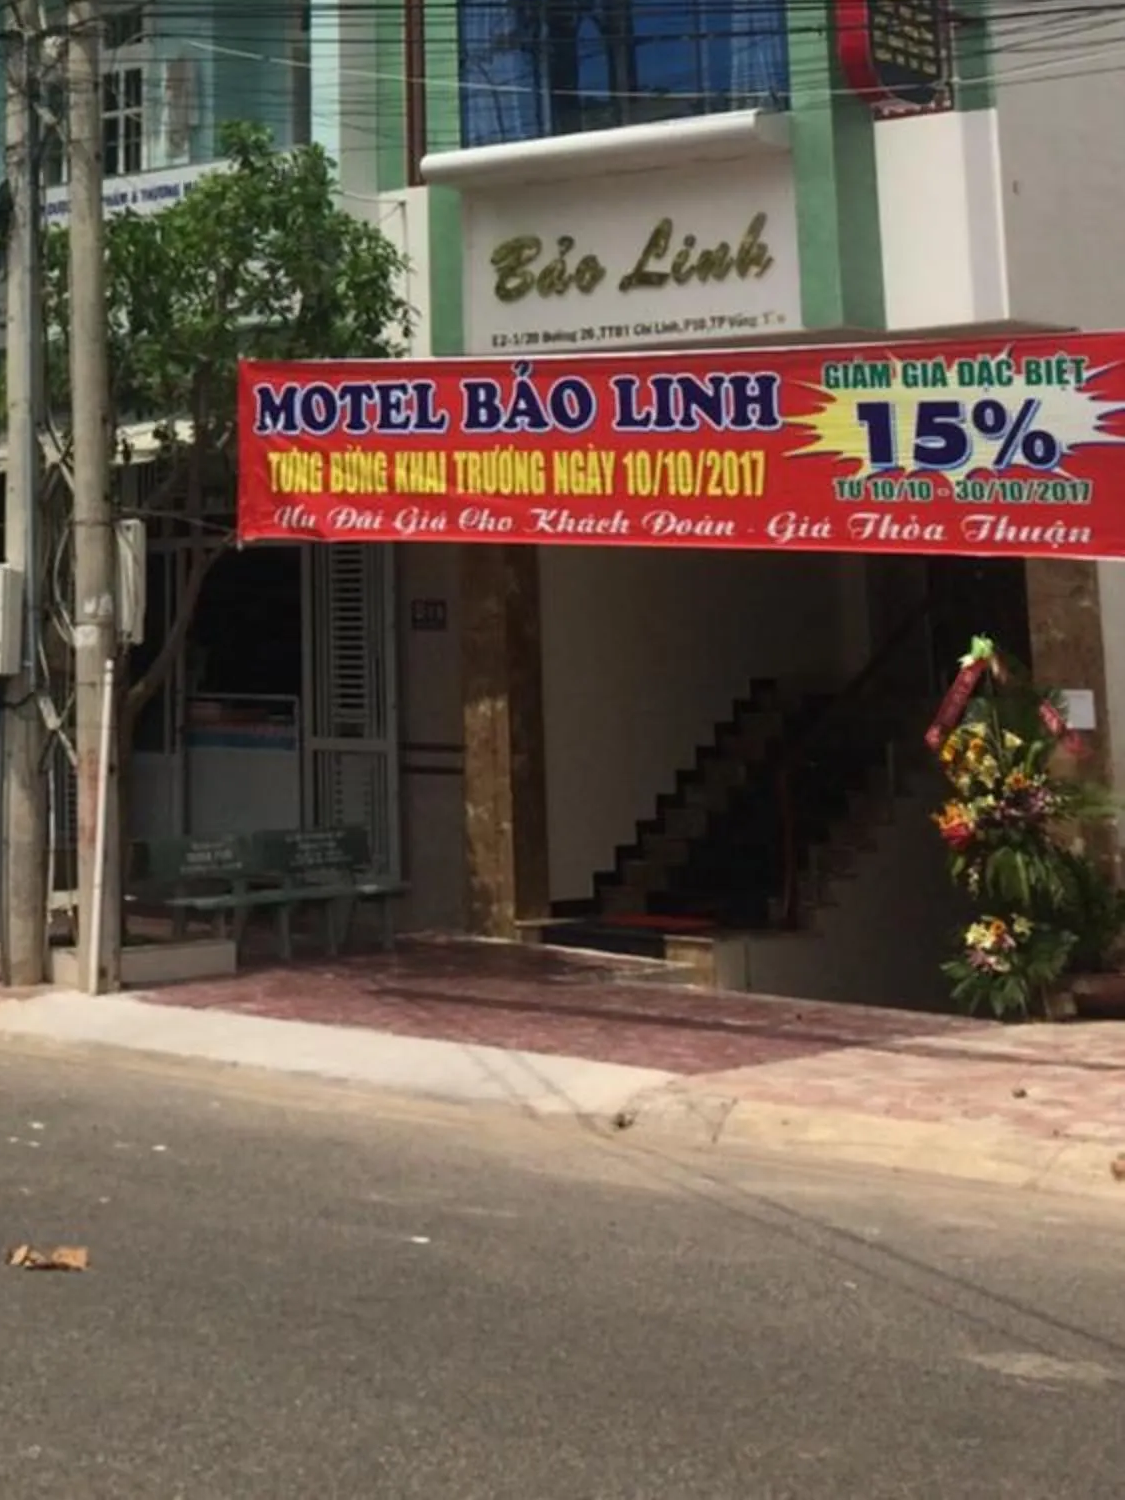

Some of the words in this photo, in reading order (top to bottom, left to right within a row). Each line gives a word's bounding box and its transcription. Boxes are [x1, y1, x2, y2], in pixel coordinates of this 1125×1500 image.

[490, 234, 607, 303] Bảo
[619, 211, 774, 294] Linh
[253, 381, 449, 437] MOTEL
[461, 359, 596, 435] BẢO
[610, 371, 784, 433] LINH
[901, 357, 949, 389] GIÁ
[1024, 352, 1089, 391] BIỆT
[856, 397, 1062, 470] 15%
[394, 450, 448, 495] KHAI
[554, 443, 616, 496] NGÀY
[623, 449, 765, 496] 10/10/2017
[868, 479, 932, 502] 10/10
[954, 479, 1093, 504] 30/10/2017
[392, 505, 448, 534] Giá
[458, 505, 513, 532] Cho
[527, 507, 630, 534] Khách
[765, 510, 832, 544] Giá
[960, 514, 1093, 549] Thuận
